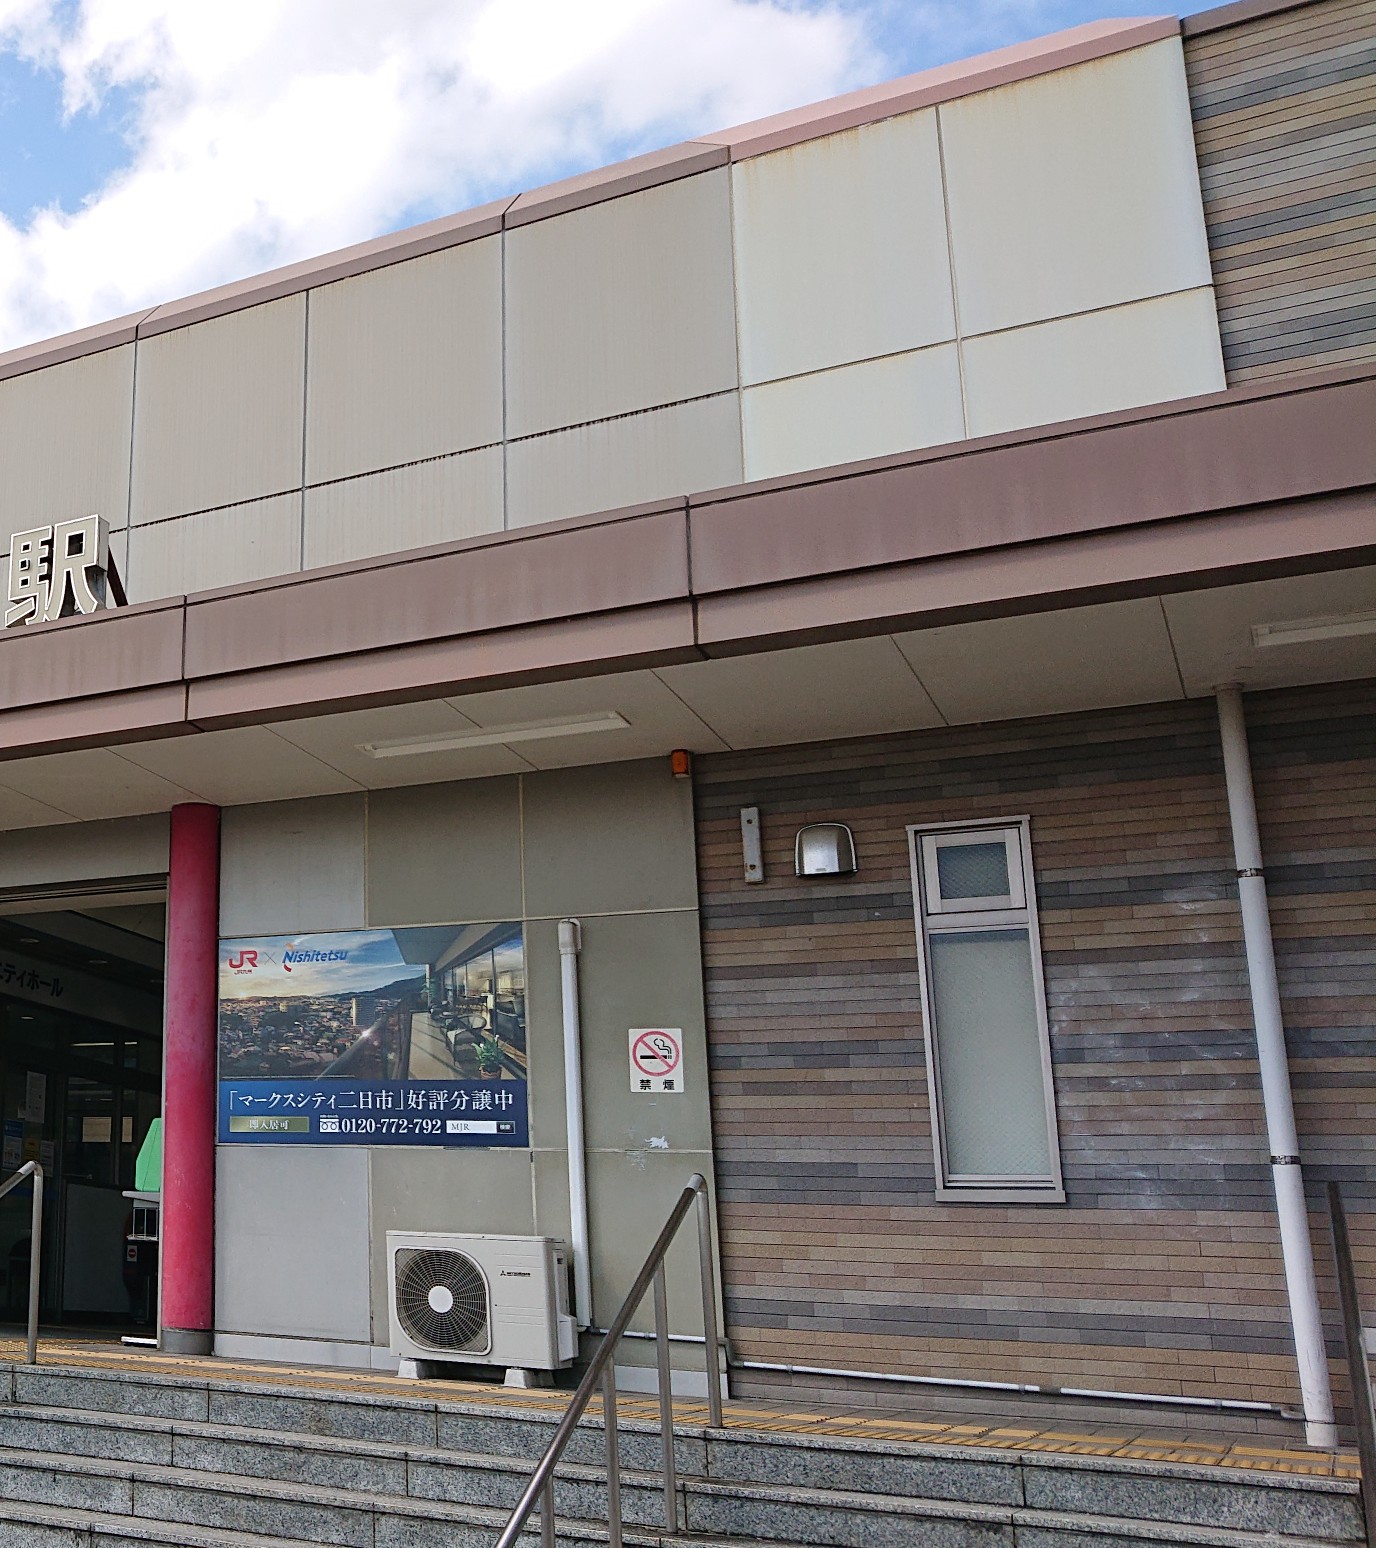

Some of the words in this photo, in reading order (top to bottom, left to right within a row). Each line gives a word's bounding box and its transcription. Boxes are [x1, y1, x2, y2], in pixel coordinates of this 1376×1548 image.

[228, 950, 259, 969] JR
[282, 949, 349, 964] Nishitetsu
[639, 1079, 675, 1091] 禁煙
[341, 1118, 442, 1135] 0120-772-792
[450, 1123, 471, 1132] MJR
